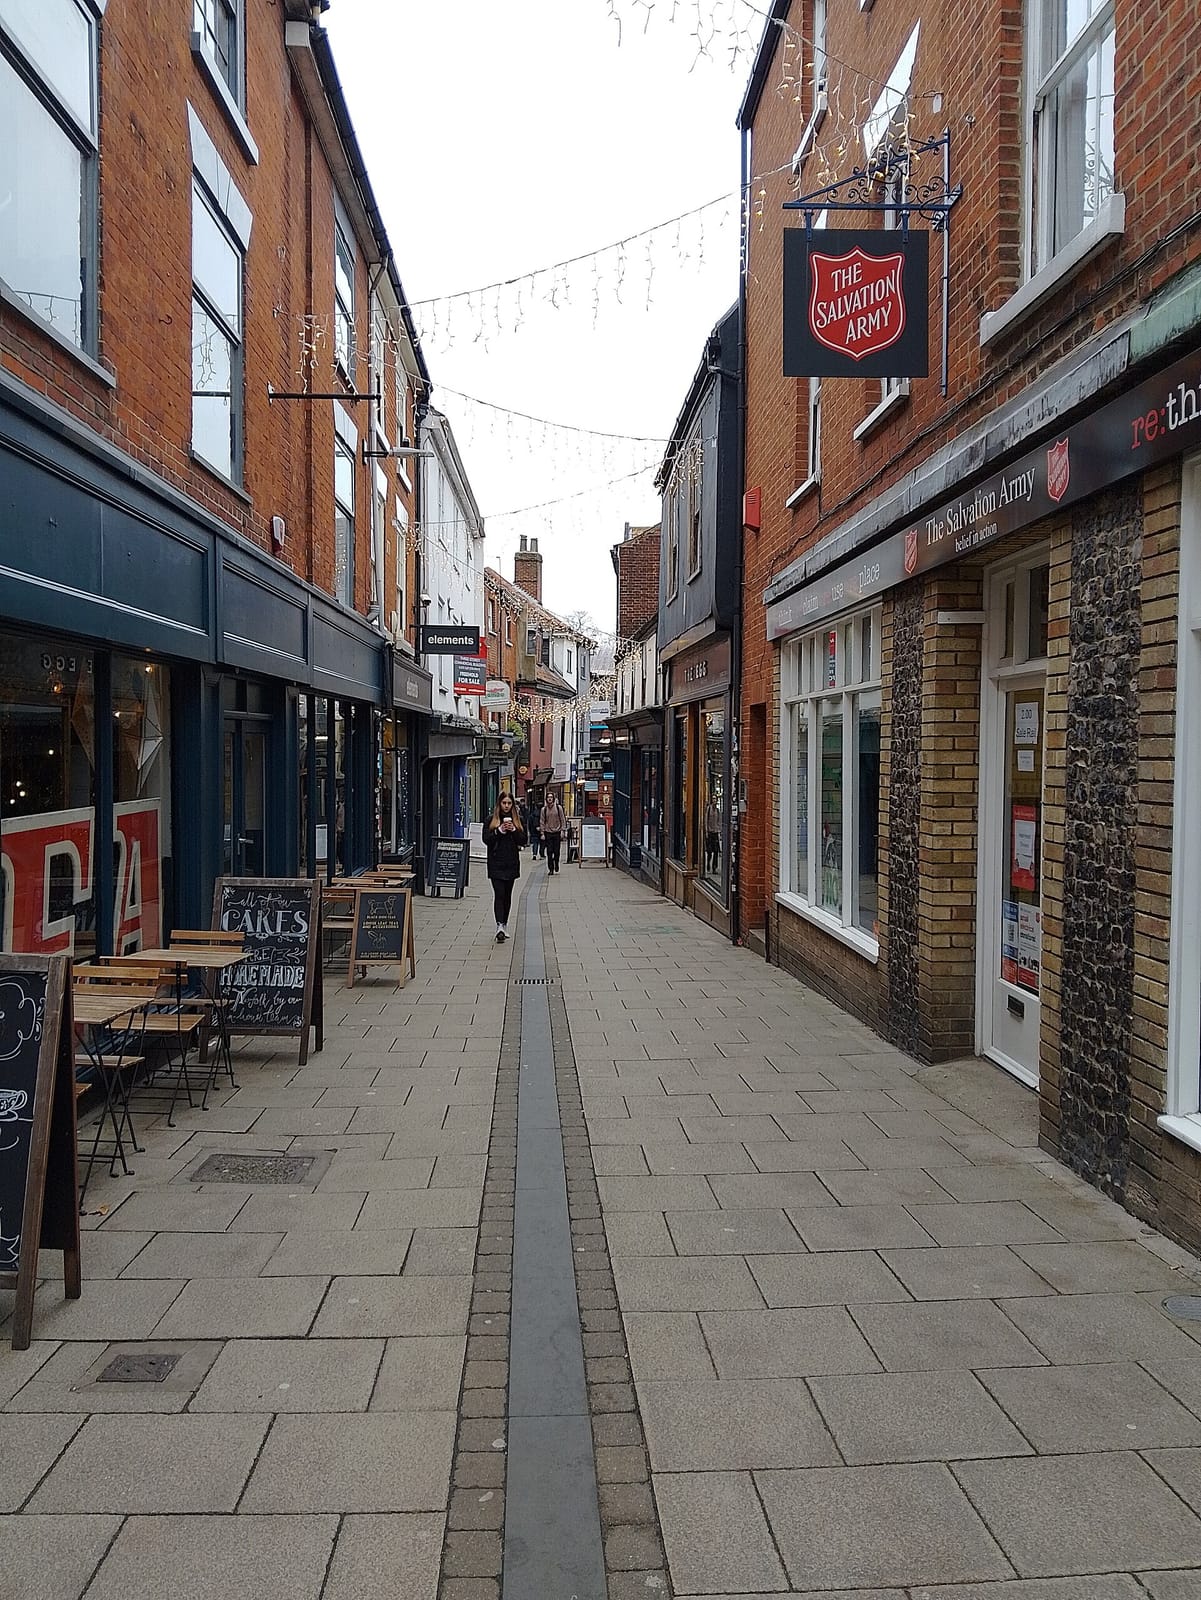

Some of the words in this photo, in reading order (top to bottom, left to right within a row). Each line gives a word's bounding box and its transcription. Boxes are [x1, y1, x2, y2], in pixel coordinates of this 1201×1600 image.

[830, 262, 863, 292] THE
[816, 269, 896, 329] SALVATION
[845, 301, 893, 345] ARMY
[925, 516, 945, 546] The
[946, 489, 997, 536] Salvation
[998, 467, 1036, 509] Army
[955, 534, 973, 553] belief
[972, 530, 979, 546] in
[978, 521, 998, 543] action
[858, 563, 880, 594] place
[428, 634, 474, 645] elements
[222, 908, 309, 935] CAKES
[273, 991, 287, 1015] by
